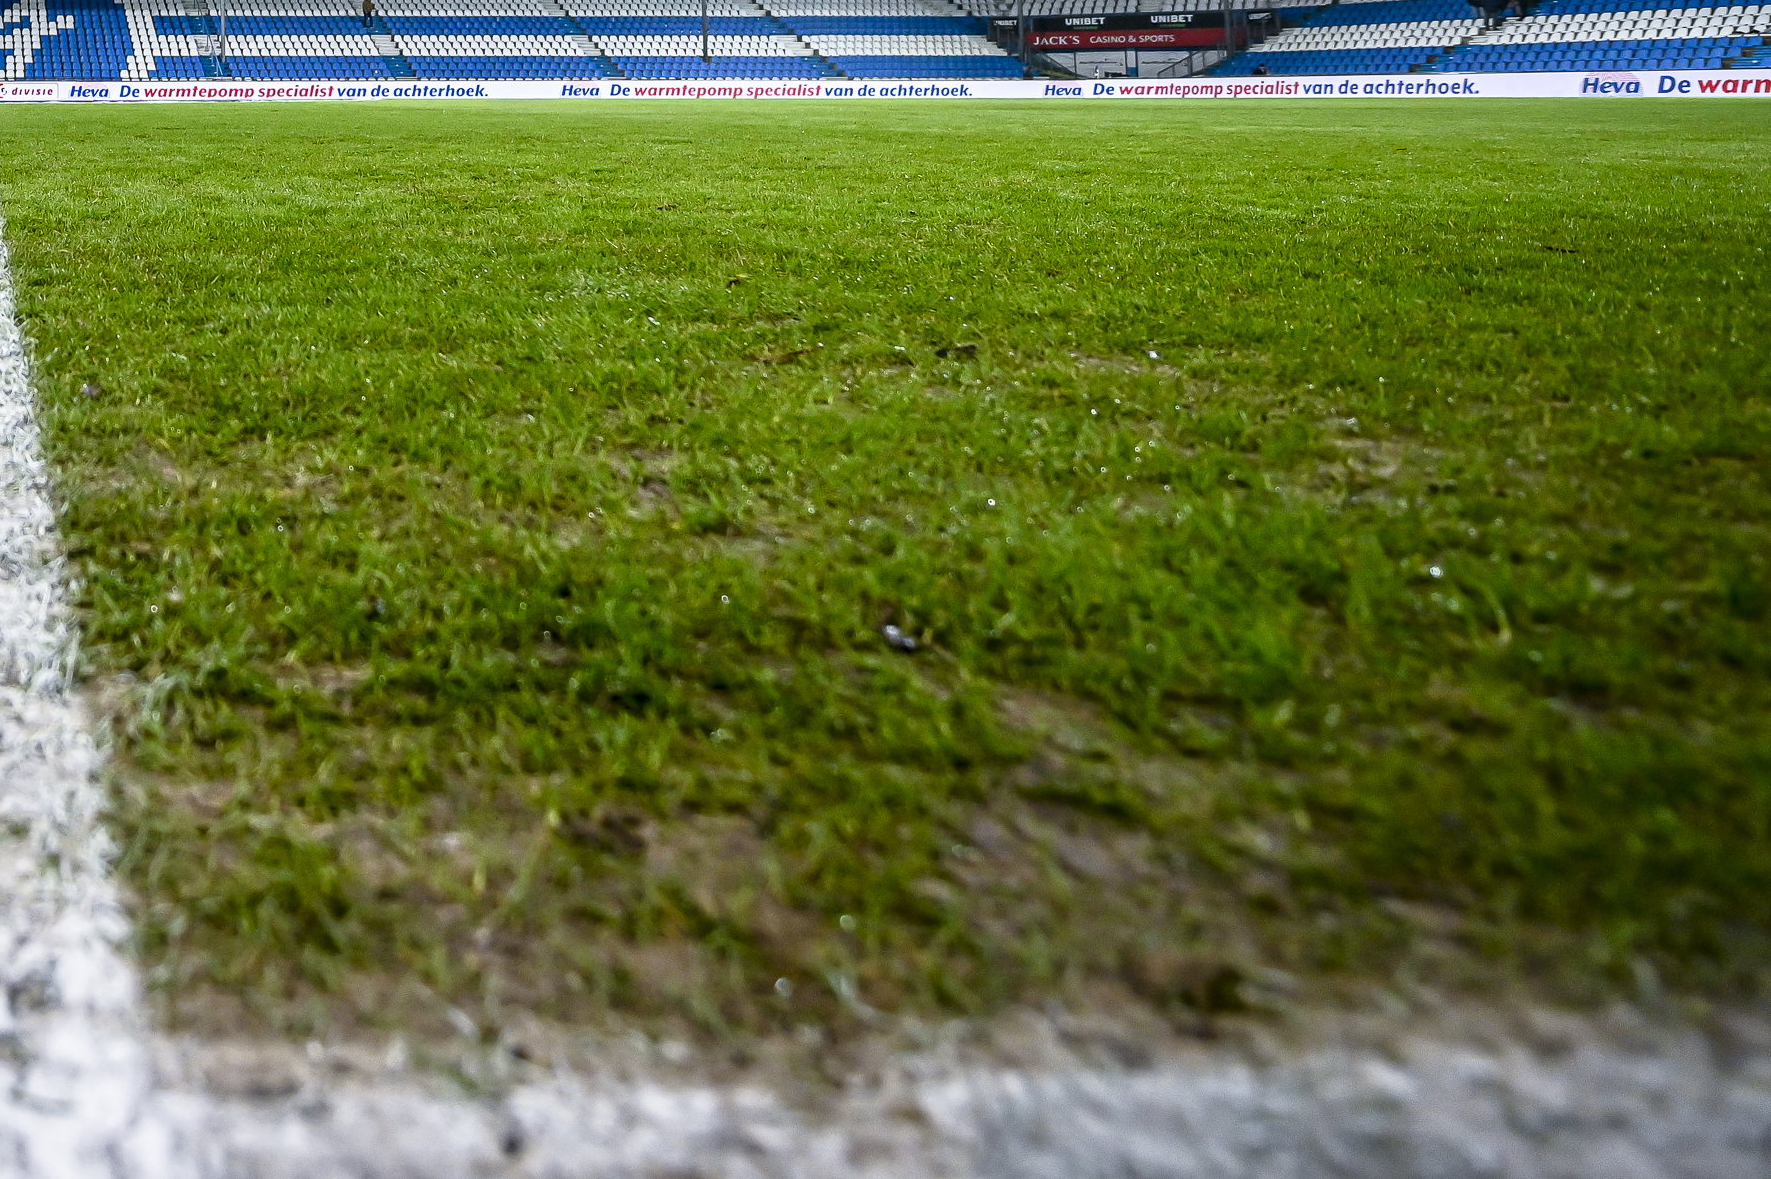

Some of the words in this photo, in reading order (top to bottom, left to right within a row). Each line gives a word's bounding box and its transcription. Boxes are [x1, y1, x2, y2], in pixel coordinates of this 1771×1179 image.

[1065, 17, 1105, 26] UNIBET
[1150, 14, 1193, 24] UNIBET
[1033, 35, 1080, 46] JACK'S
[1089, 34, 1127, 44] CASINO
[1128, 34, 1137, 43] &
[1138, 33, 1176, 44] SPORTS
[120, 85, 140, 97] De
[144, 84, 254, 98] warmtepomp
[258, 84, 334, 98] specialist
[338, 87, 367, 97] van
[371, 85, 390, 97] de
[394, 85, 489, 97] achterhoek.
[562, 85, 600, 96] Heva
[610, 84, 630, 96] De
[635, 84, 743, 98] warmtepomp
[746, 85, 821, 98] specialist
[825, 87, 853, 97] van
[858, 84, 876, 97] de
[880, 85, 972, 97] achterhoek.
[1045, 85, 1082, 96] Heva
[1093, 83, 1114, 96] De
[1120, 82, 1223, 98] warmtepomp
[1226, 81, 1299, 98] specialist
[1303, 84, 1333, 95] van
[1339, 80, 1359, 95] de
[1363, 78, 1479, 94] achterhoek.
[1582, 78, 1640, 94] Heva
[1658, 76, 1690, 93] De
[11, 86, 54, 97] divisie
[70, 85, 108, 98] Heva
